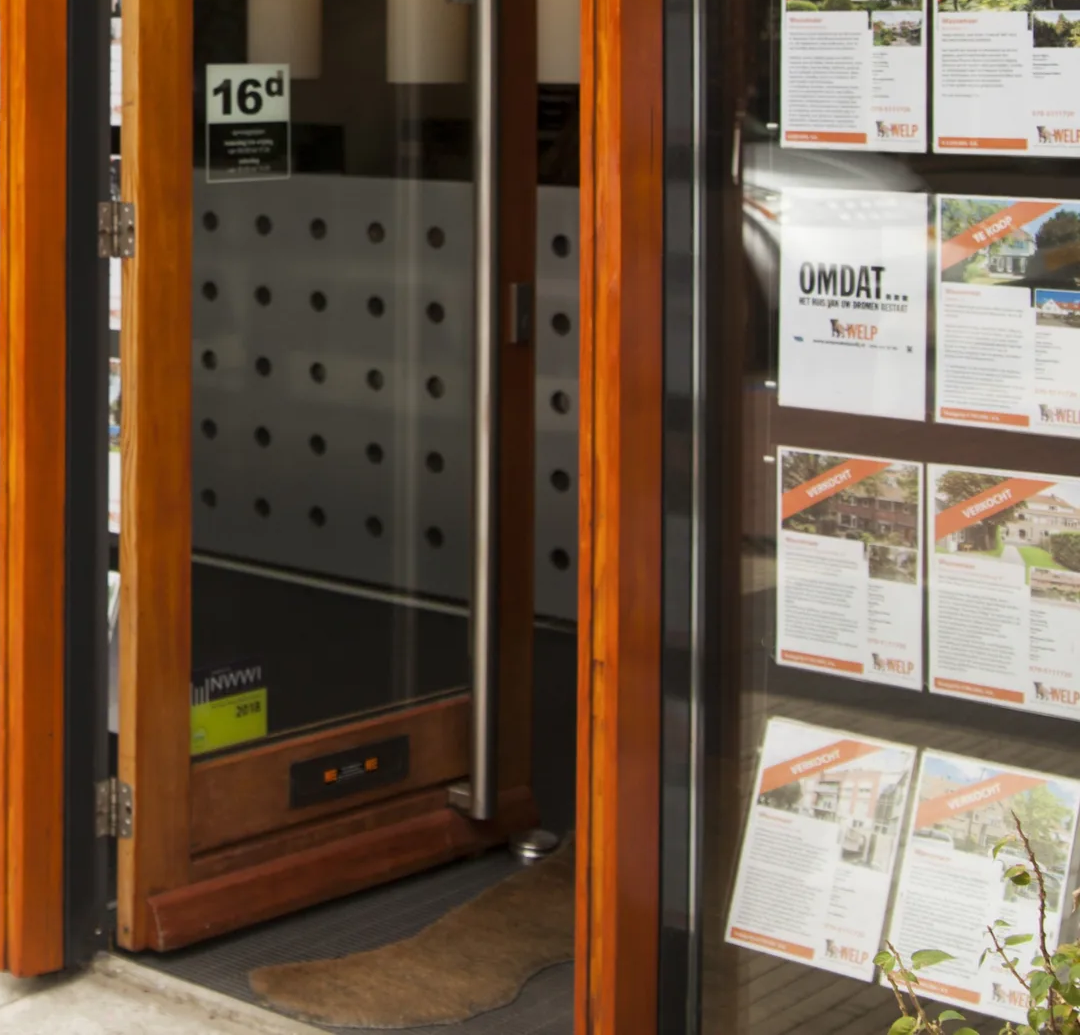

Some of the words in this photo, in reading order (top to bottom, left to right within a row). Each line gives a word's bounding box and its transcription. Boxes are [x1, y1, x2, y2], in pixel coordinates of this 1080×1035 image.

[891, 124, 918, 137] WELP
[972, 231, 986, 244] TE
[985, 216, 1012, 237] KOOP
[799, 261, 909, 301] OMDAT...
[846, 323, 878, 341] WELP
[887, 658, 914, 674] WELP
[1050, 686, 1080, 705] WELP
